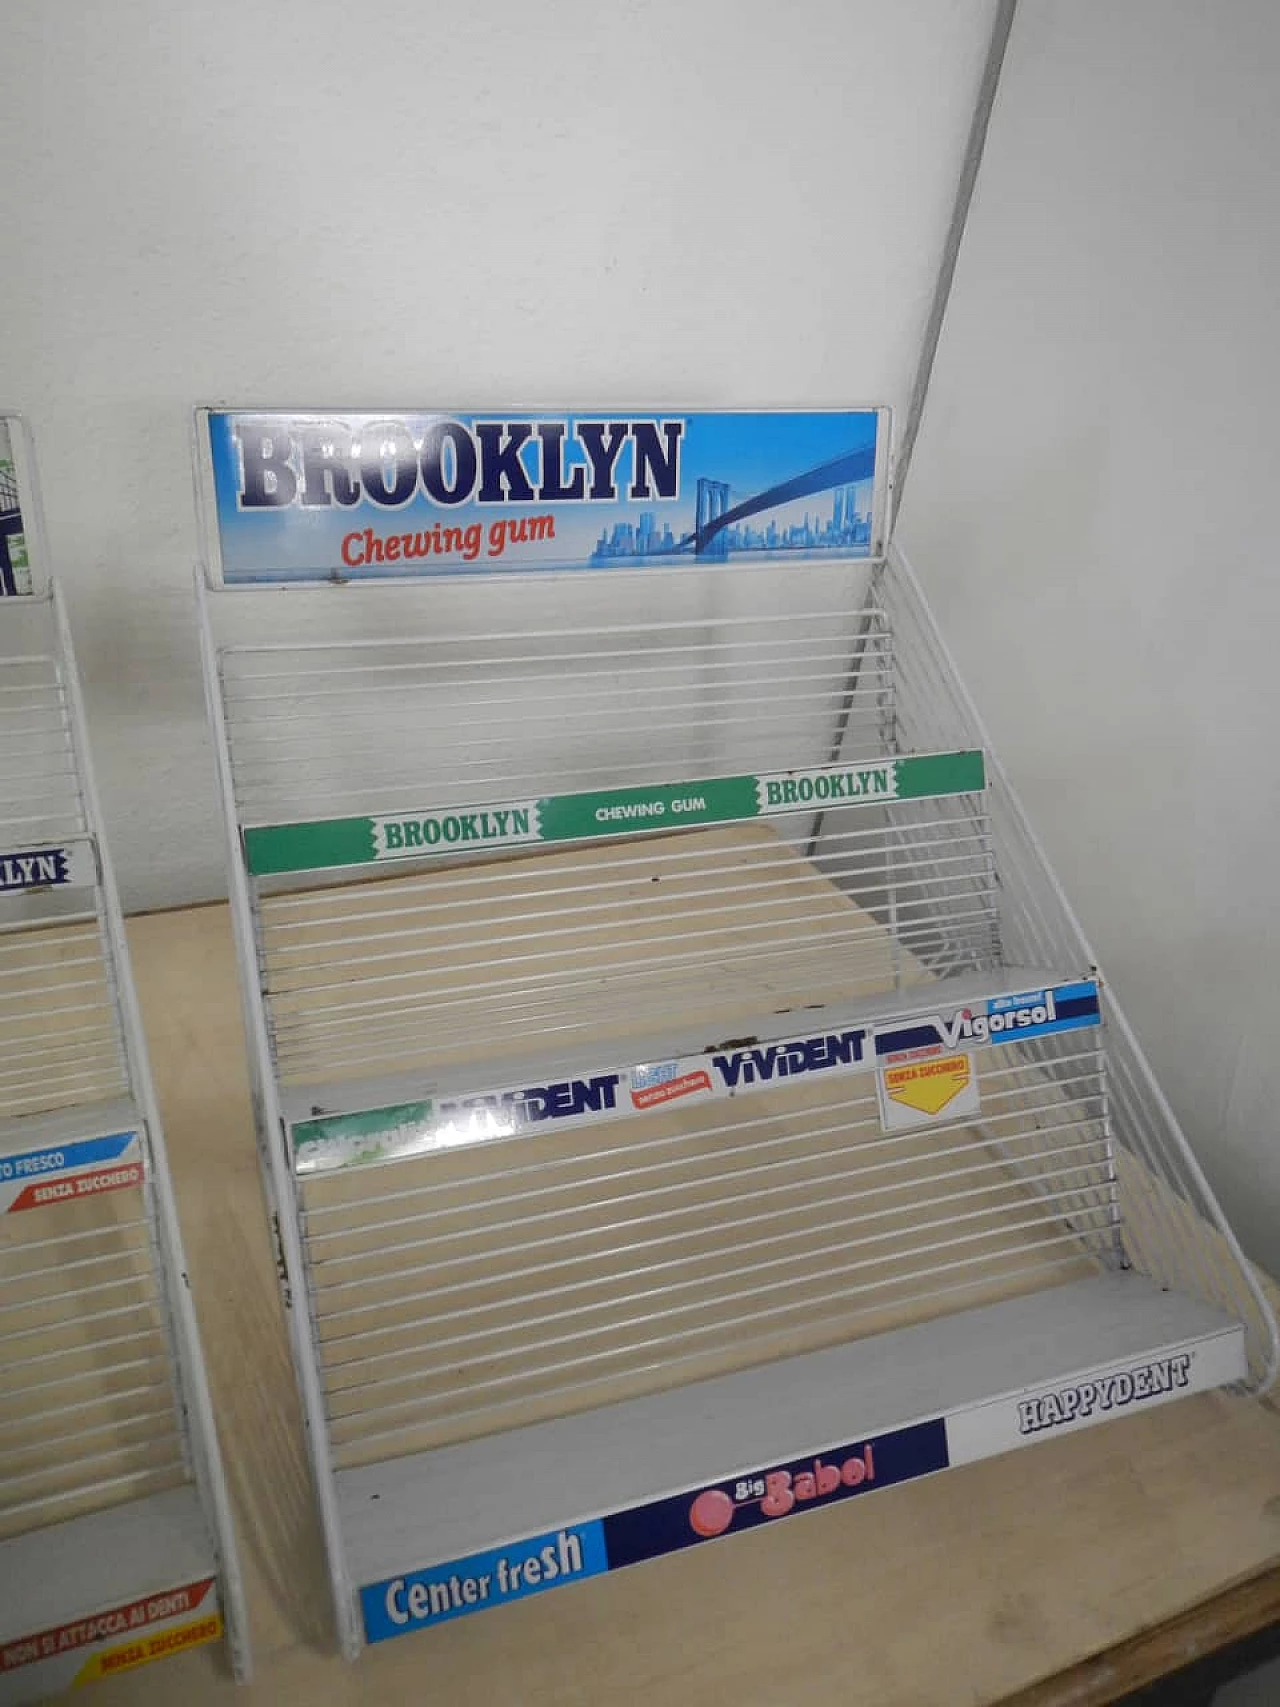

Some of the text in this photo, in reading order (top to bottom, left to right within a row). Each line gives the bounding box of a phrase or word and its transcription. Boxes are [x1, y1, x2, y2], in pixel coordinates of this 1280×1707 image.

[234, 419, 685, 510] BROOKLYN
[341, 515, 556, 567] Chewing gum
[384, 769, 889, 849] BROOKLYN CHEWING GUM BROOKLYN
[930, 990, 1057, 1048] Vigorsol
[16, 1151, 65, 1174] FRESCO
[1016, 1355, 1191, 1437] HAPPYDENT
[735, 1444, 875, 1518] Big Babol
[385, 1530, 583, 1626] Center fresh
